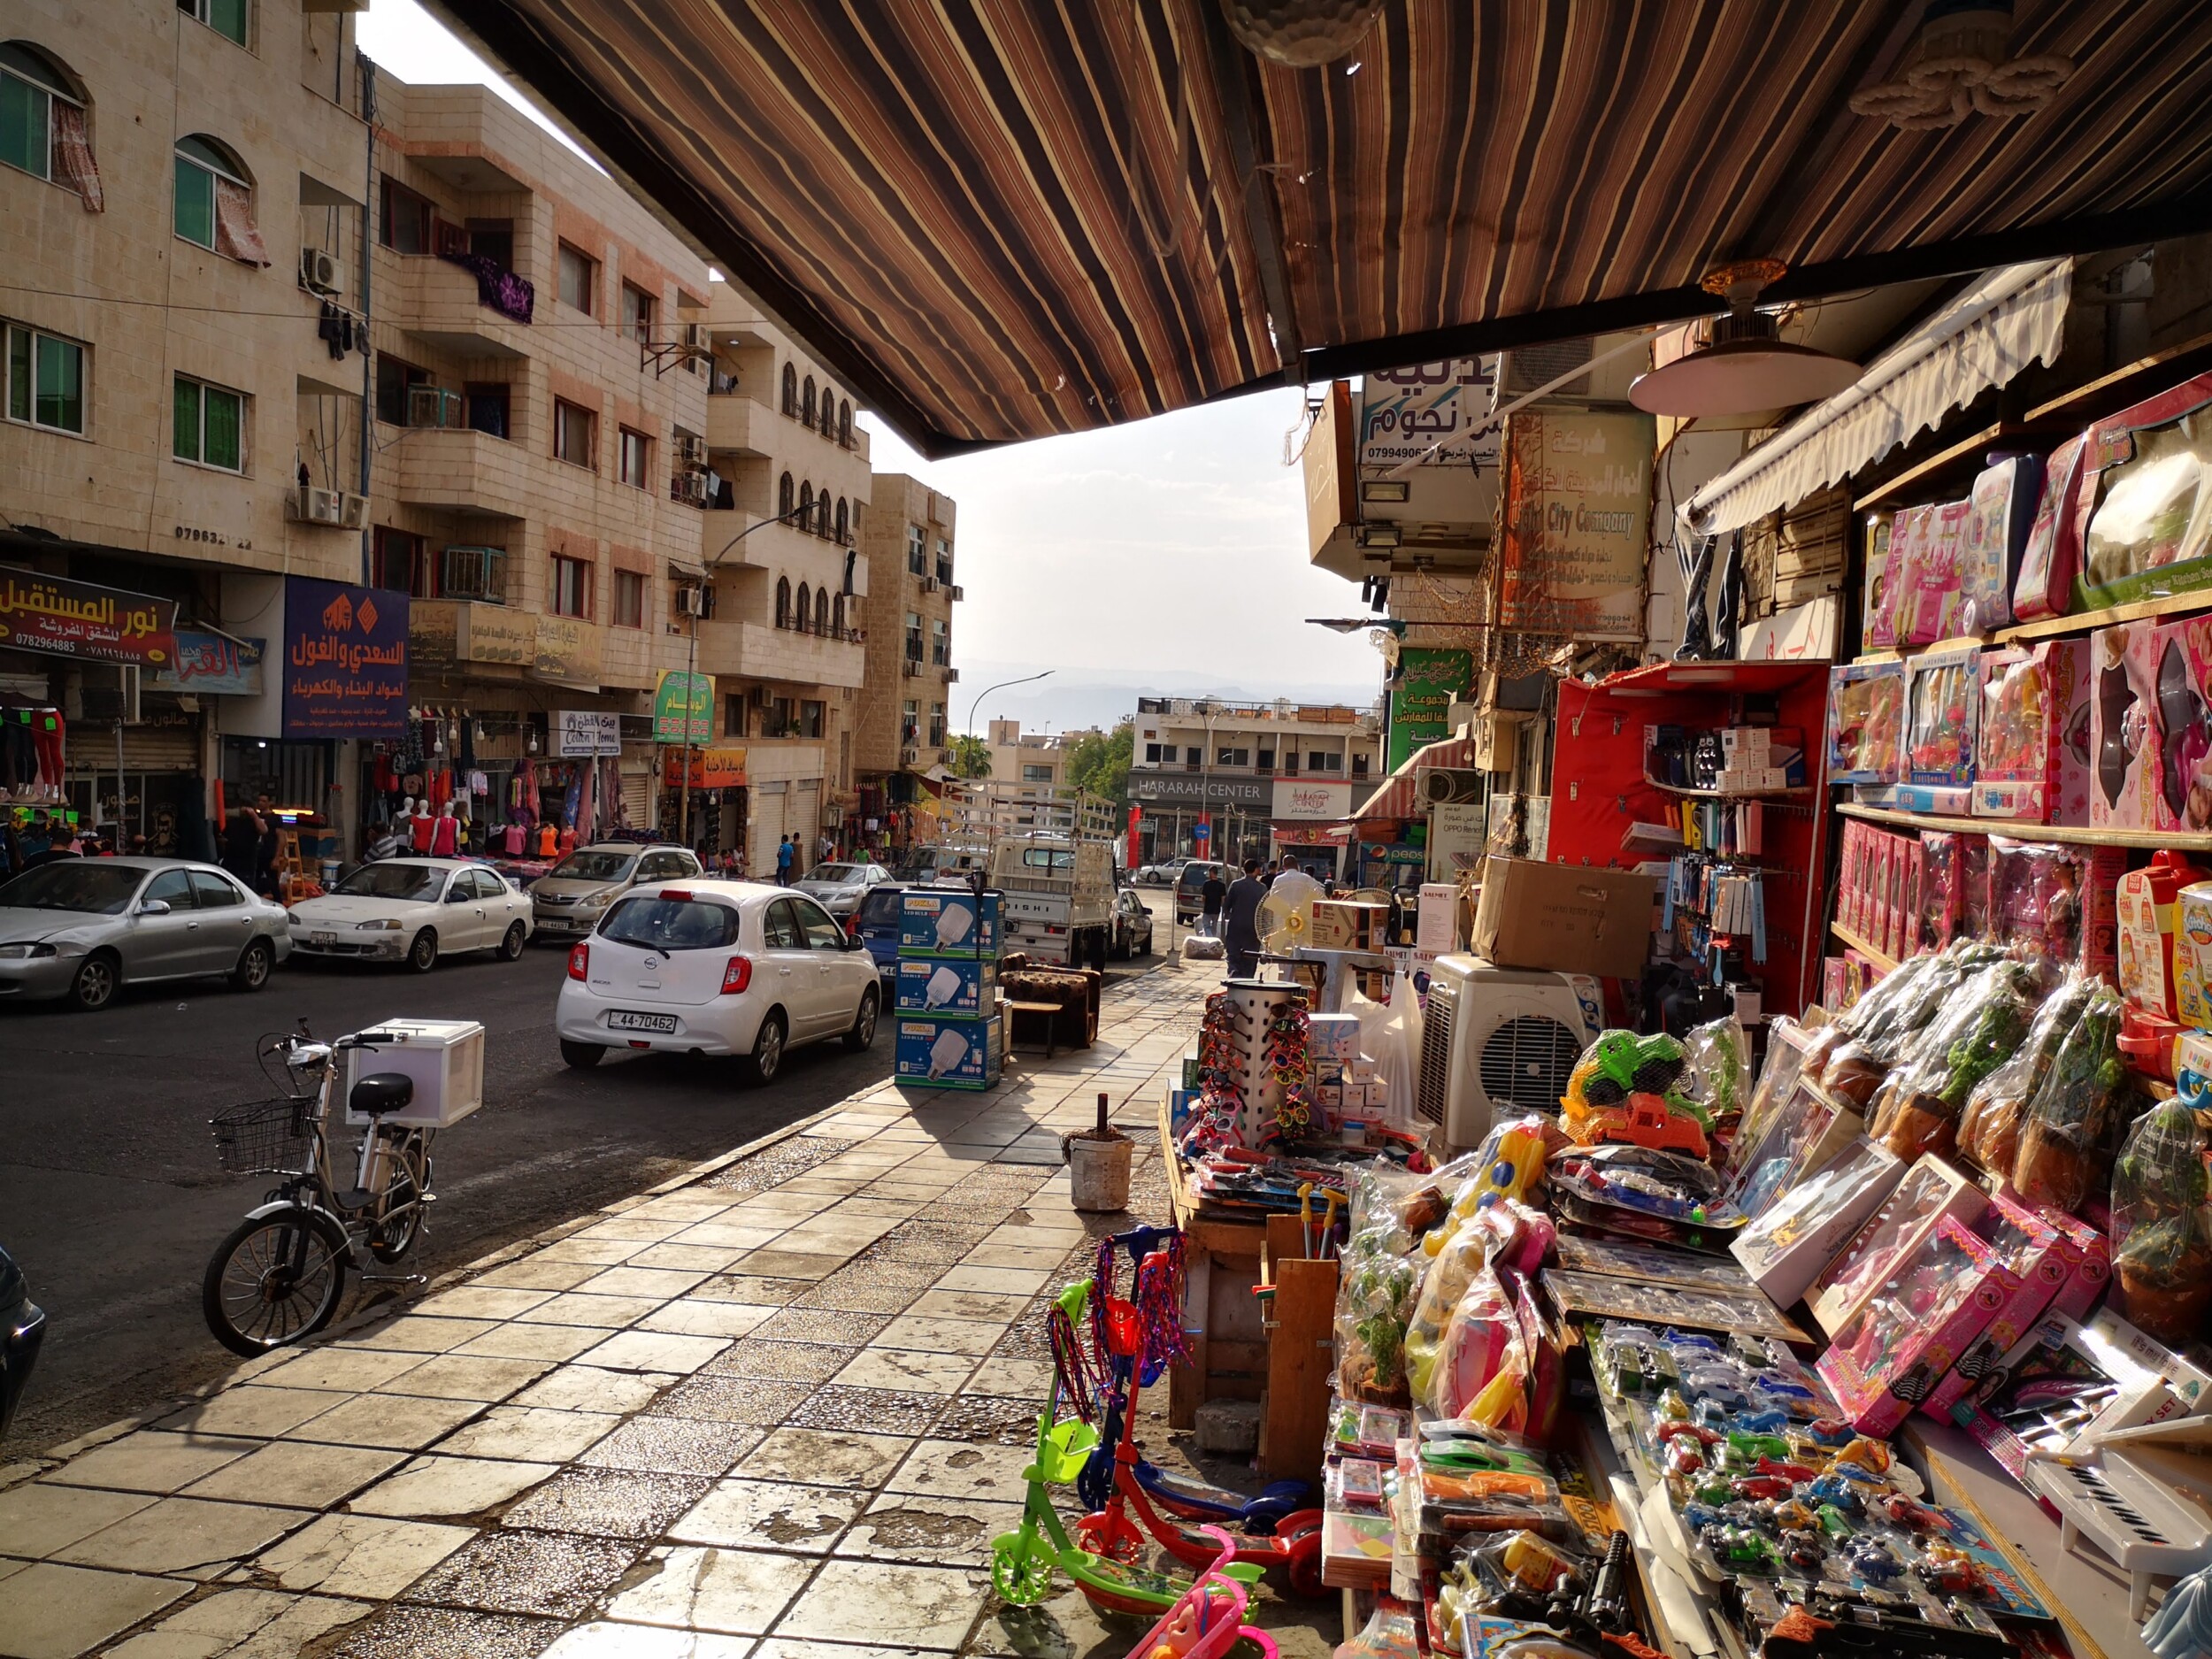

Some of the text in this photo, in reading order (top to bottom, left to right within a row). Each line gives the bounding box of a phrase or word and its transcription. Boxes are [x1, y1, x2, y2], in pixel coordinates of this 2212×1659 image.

[1369, 401, 1456, 441] نجوم
[1548, 502, 1573, 538] City
[1576, 503, 1635, 540] Company
[2171, 572, 2201, 586] Kitchen
[0, 580, 157, 638] نور المستقبل
[39, 618, 119, 641] للشقق المفروشة
[16, 634, 75, 652] 0782964885
[86, 646, 141, 661] ٠٧٨٢٩٦٤٨٨٥
[292, 634, 404, 673] السعدي والغول
[293, 678, 403, 700] لمواد البناء والكهرباء
[1139, 780, 1261, 798] HARARAH CENTER
[1443, 824, 1463, 833] OPPO
[1391, 849, 1423, 860] peps
[2185, 915, 2212, 933] Kitche
[620, 1014, 673, 1030] 44-70462
[2145, 1348, 2161, 1363] my
[2161, 1354, 2179, 1378] love
[2155, 1398, 2177, 1419] SET
[1973, 1417, 1990, 1440] GIRL
